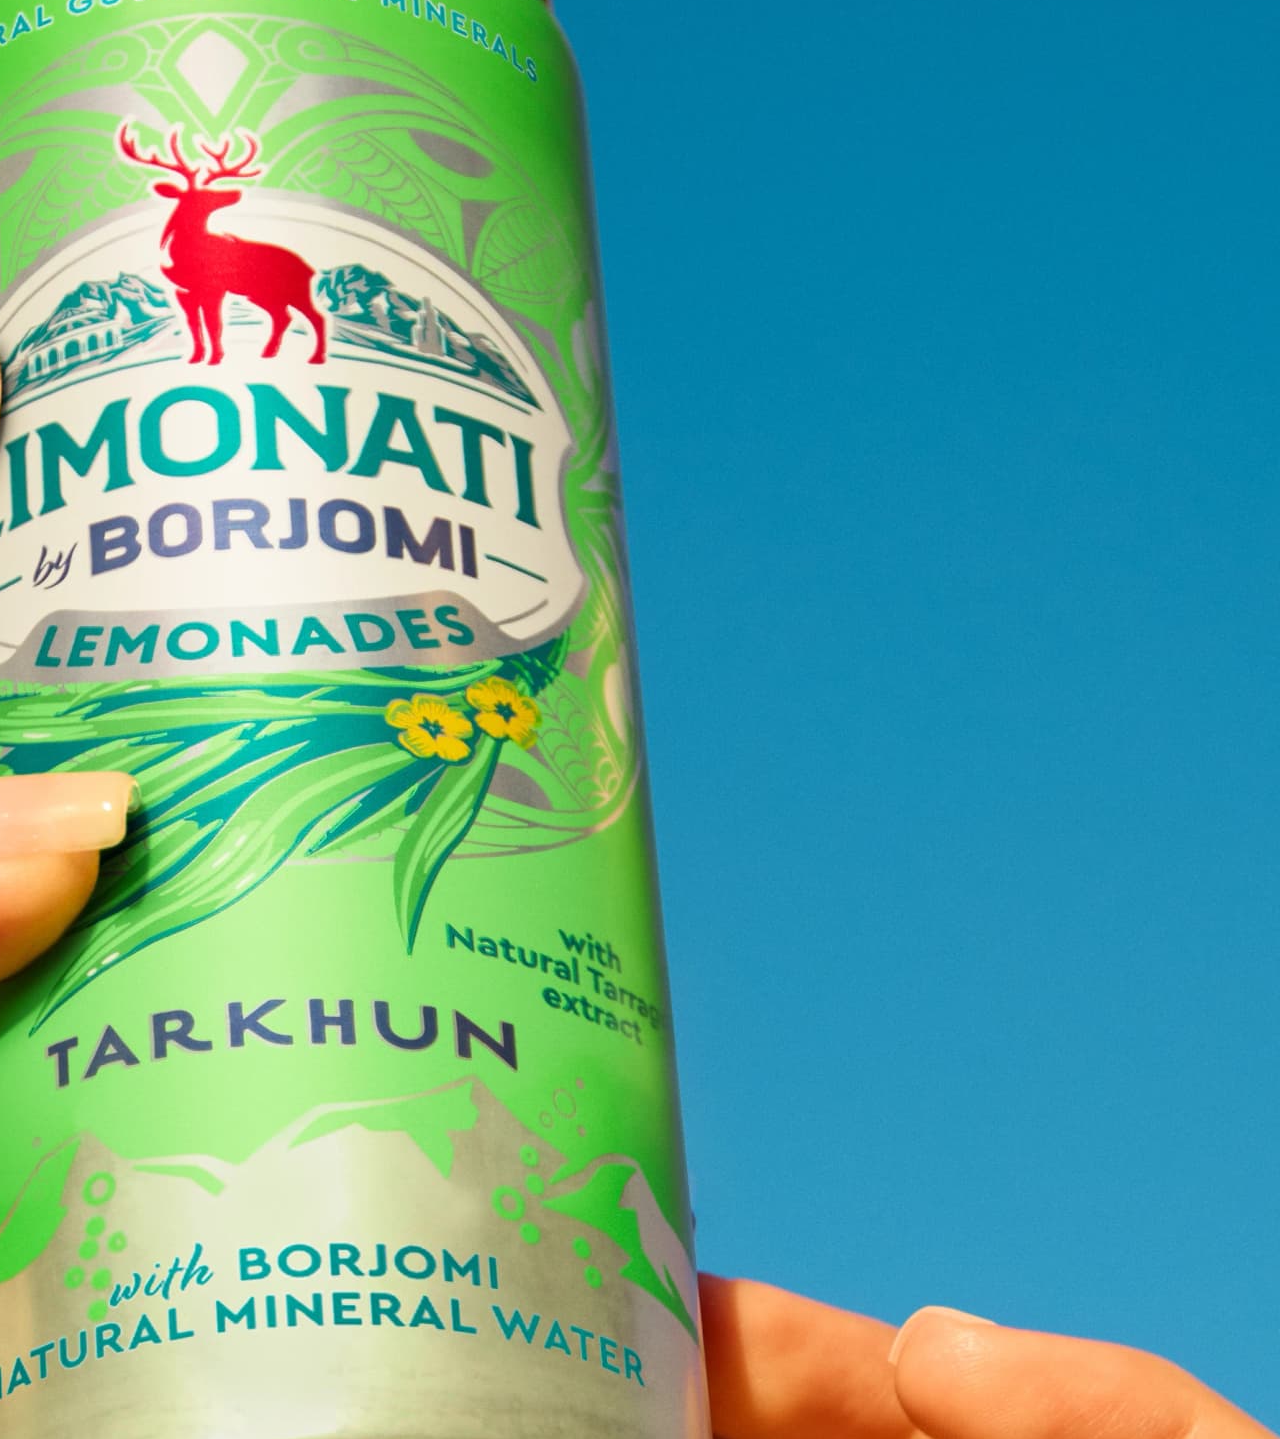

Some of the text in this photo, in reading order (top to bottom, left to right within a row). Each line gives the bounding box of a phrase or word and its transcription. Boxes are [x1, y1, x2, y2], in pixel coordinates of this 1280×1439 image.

[32, 497, 479, 590] by BORJOMI
[35, 604, 476, 668] LEMONADES
[445, 922, 580, 985] Natural
[558, 928, 622, 973] with
[46, 997, 519, 1090] TARKHUN
[542, 986, 643, 1046] extract
[108, 1242, 500, 1309] with BORJOMI
[215, 1291, 479, 1335] MINERAL
[492, 1304, 647, 1388] WATER
